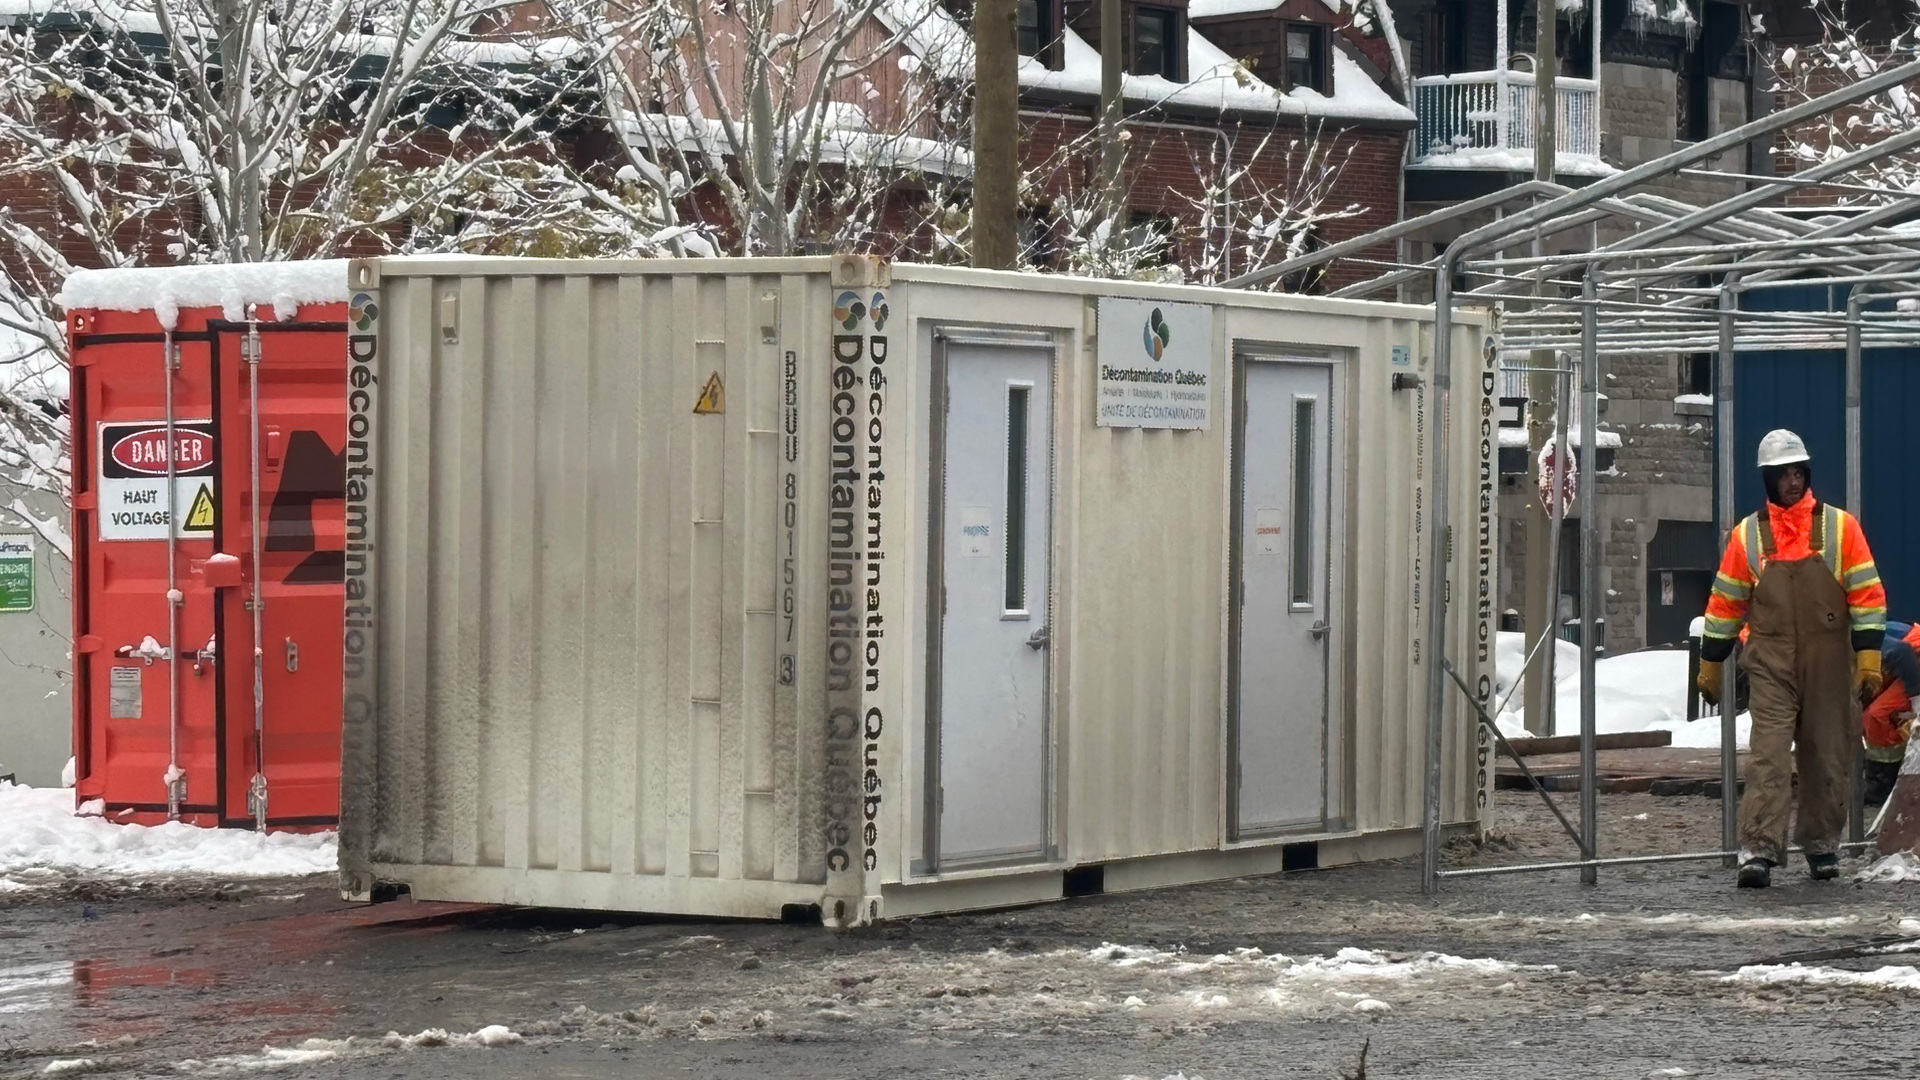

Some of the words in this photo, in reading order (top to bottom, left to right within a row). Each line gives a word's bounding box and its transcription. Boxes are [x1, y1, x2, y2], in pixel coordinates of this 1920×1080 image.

[1101, 364, 1174, 384] Décontamination
[1174, 369, 1207, 387] Québec
[0, 563, 29, 575] ENDRE
[111, 511, 170, 527] VOLTAGE
[122, 489, 158, 504] HAUT
[783, 472, 796, 642] 801567
[828, 334, 864, 691] Décontamination
[865, 336, 888, 692] Décontamination
[1479, 372, 1495, 662] Décontamination
[864, 706, 883, 872] Québec
